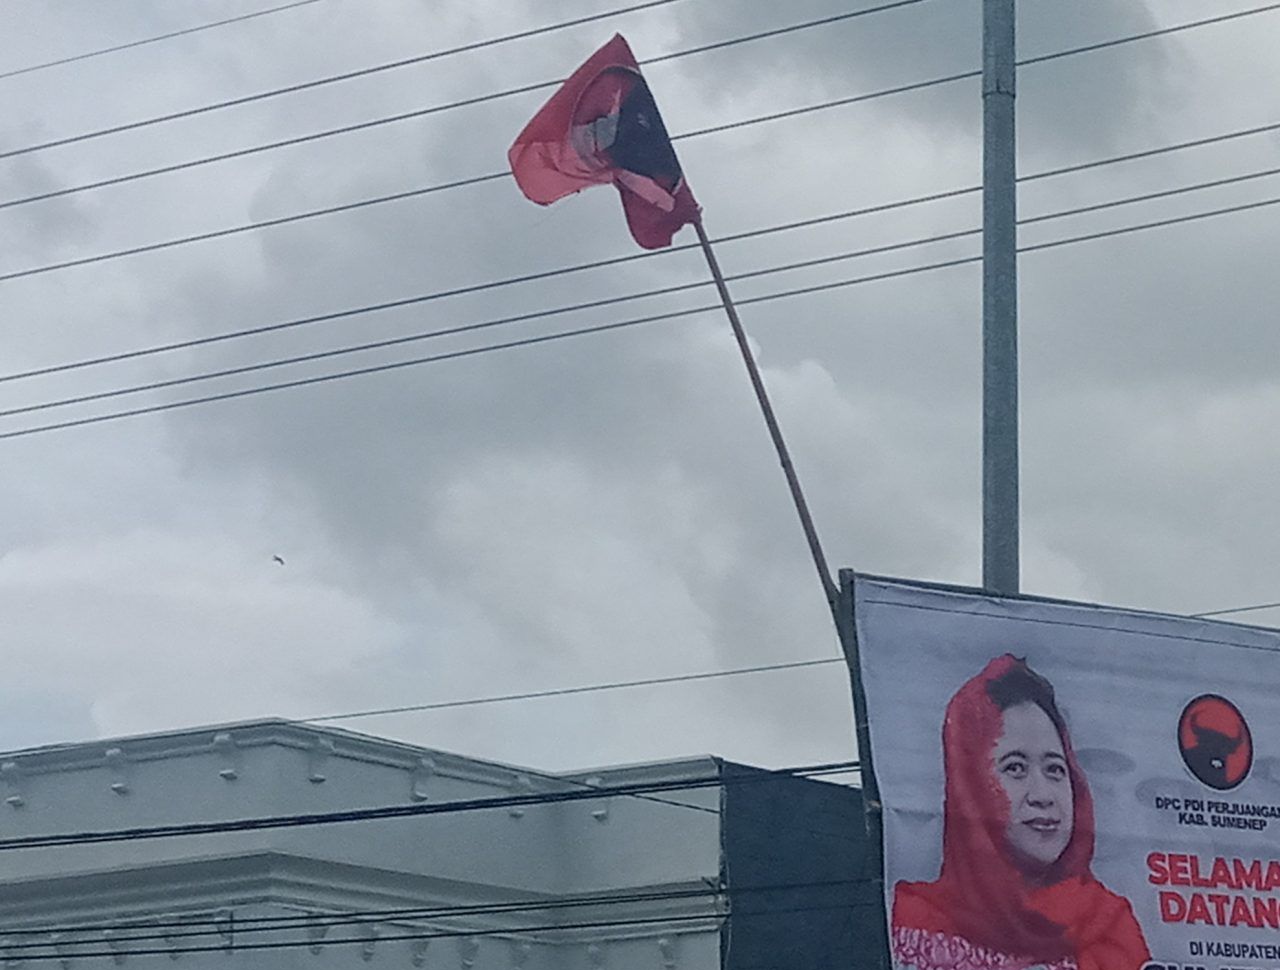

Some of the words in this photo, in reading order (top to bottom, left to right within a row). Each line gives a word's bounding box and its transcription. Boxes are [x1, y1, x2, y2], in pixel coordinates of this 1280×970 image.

[1155, 796, 1181, 810] DPC
[1184, 798, 1205, 812] PDI
[1178, 811, 1208, 826] KAB.
[1211, 814, 1267, 831] SUMENEP
[1189, 941, 1204, 957] DI
